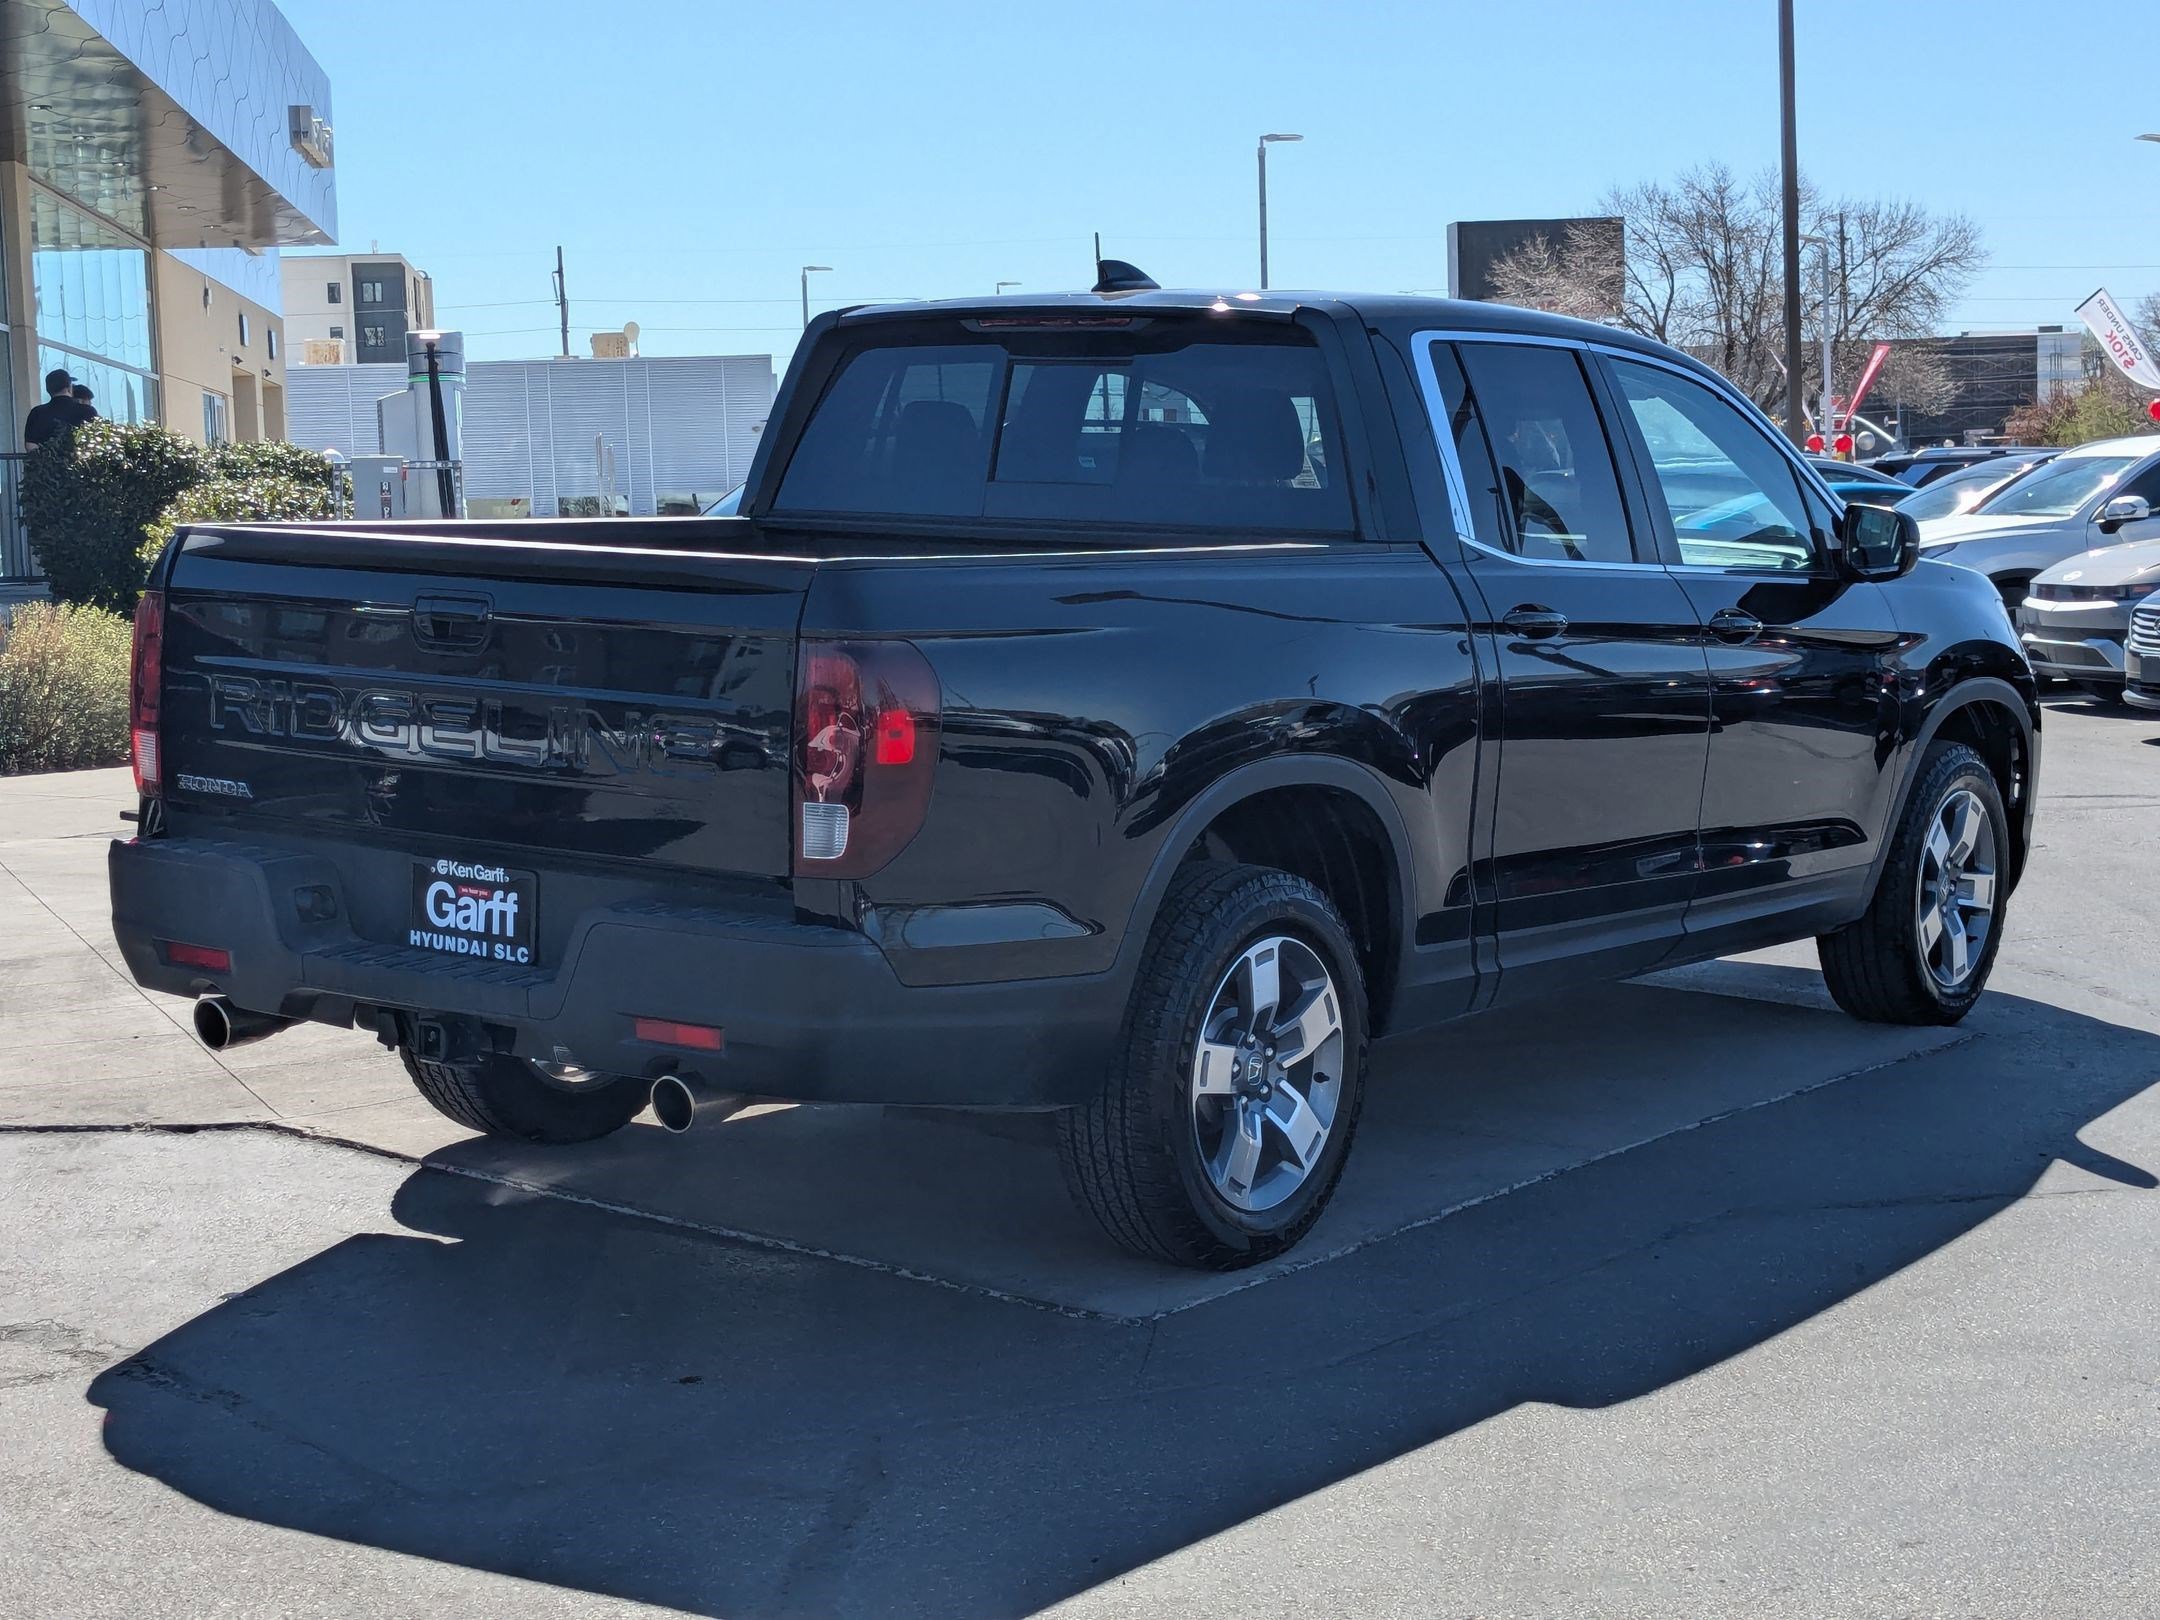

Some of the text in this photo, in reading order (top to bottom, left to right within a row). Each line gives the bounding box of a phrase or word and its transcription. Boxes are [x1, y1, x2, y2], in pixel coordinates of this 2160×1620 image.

[177, 773, 253, 798] HONDA
[426, 880, 518, 937] Garff
[410, 929, 529, 963] HYUNDAI SLC
